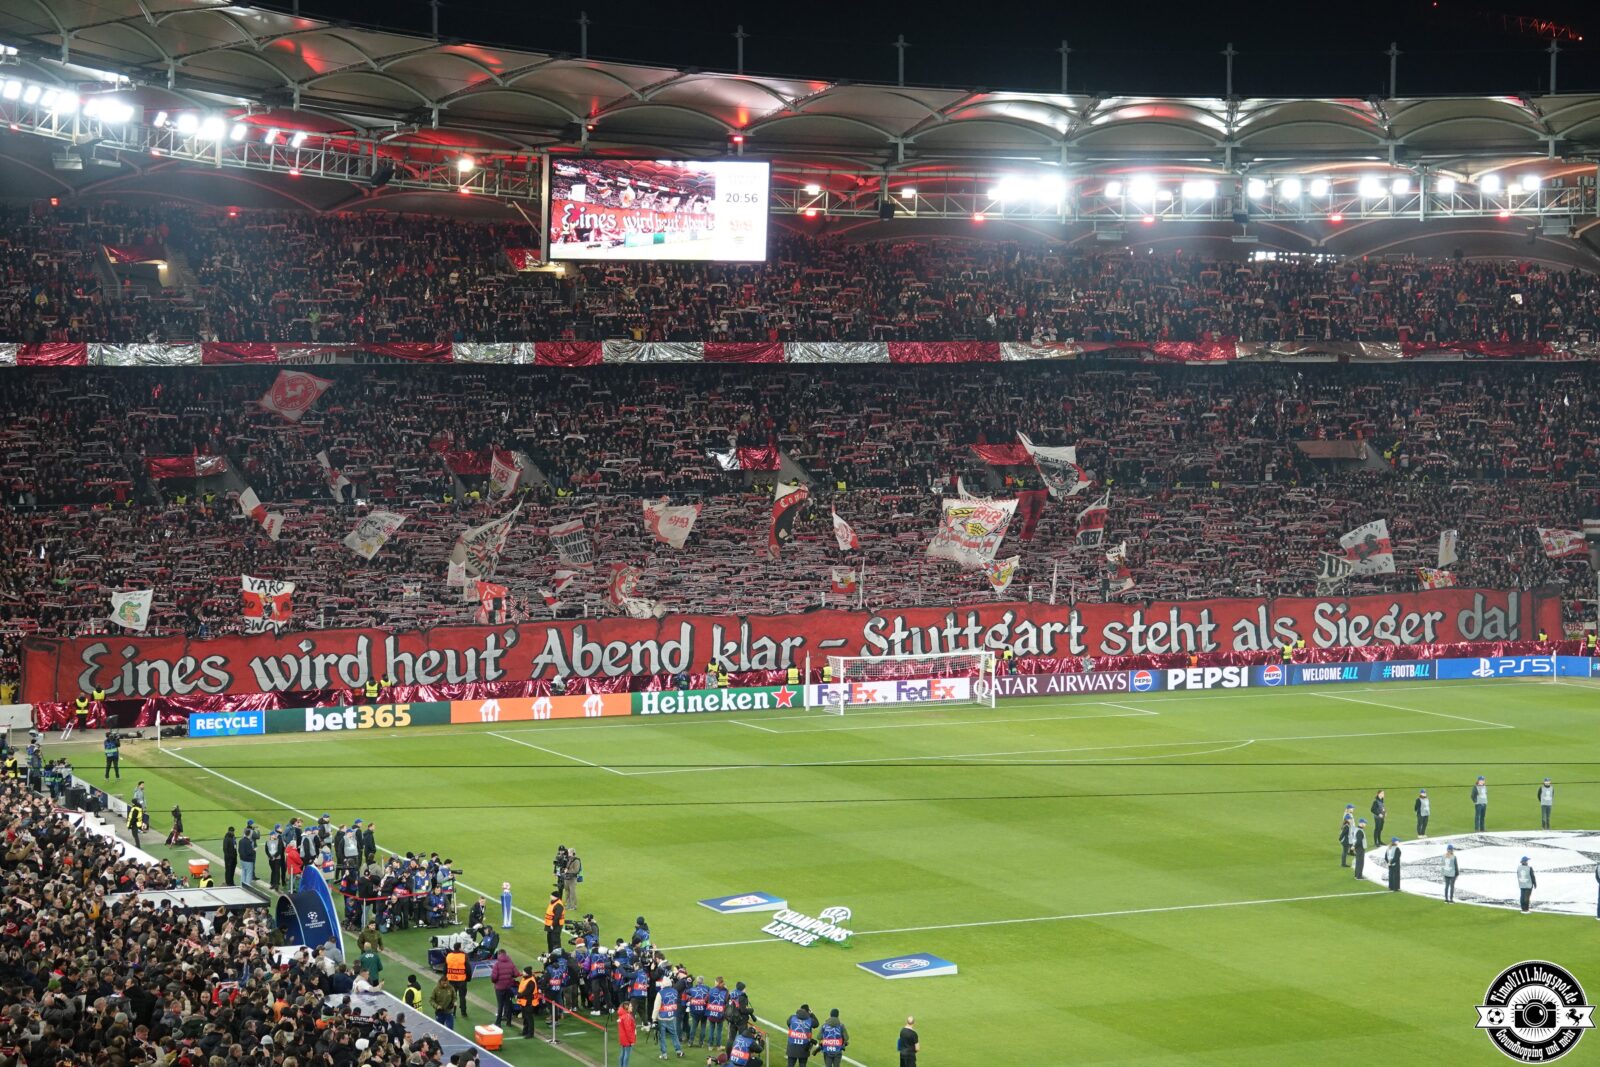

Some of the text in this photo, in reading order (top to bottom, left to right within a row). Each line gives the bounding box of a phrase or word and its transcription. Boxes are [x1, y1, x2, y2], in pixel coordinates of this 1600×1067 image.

[725, 193, 758, 203] 20:56
[562, 204, 616, 229] Eines
[78, 642, 231, 696] Eines
[250, 635, 370, 691] wird
[386, 628, 517, 686] heut'
[532, 622, 692, 679] Abend
[711, 622, 803, 673] klar
[860, 609, 1086, 659] Stuttgart
[1100, 606, 1218, 656] steht
[1232, 605, 1298, 651] als
[1313, 602, 1444, 649] Sieger
[1457, 592, 1520, 642] da!
[1167, 666, 1249, 690] PEPSI
[1302, 667, 1359, 681] WELCOME ALL
[1382, 664, 1430, 678] #FOOTBALL
[1499, 659, 1551, 674] PS5
[817, 683, 878, 705] FedEx
[896, 680, 956, 701] FedEx
[973, 673, 1128, 698] QATAR AIRWAYS
[640, 689, 770, 715] Heineken
[195, 716, 258, 731] RECYCLE
[305, 705, 411, 732] bet365
[761, 921, 820, 947] LEAGUE
[772, 908, 854, 942] CHAMPIONS
